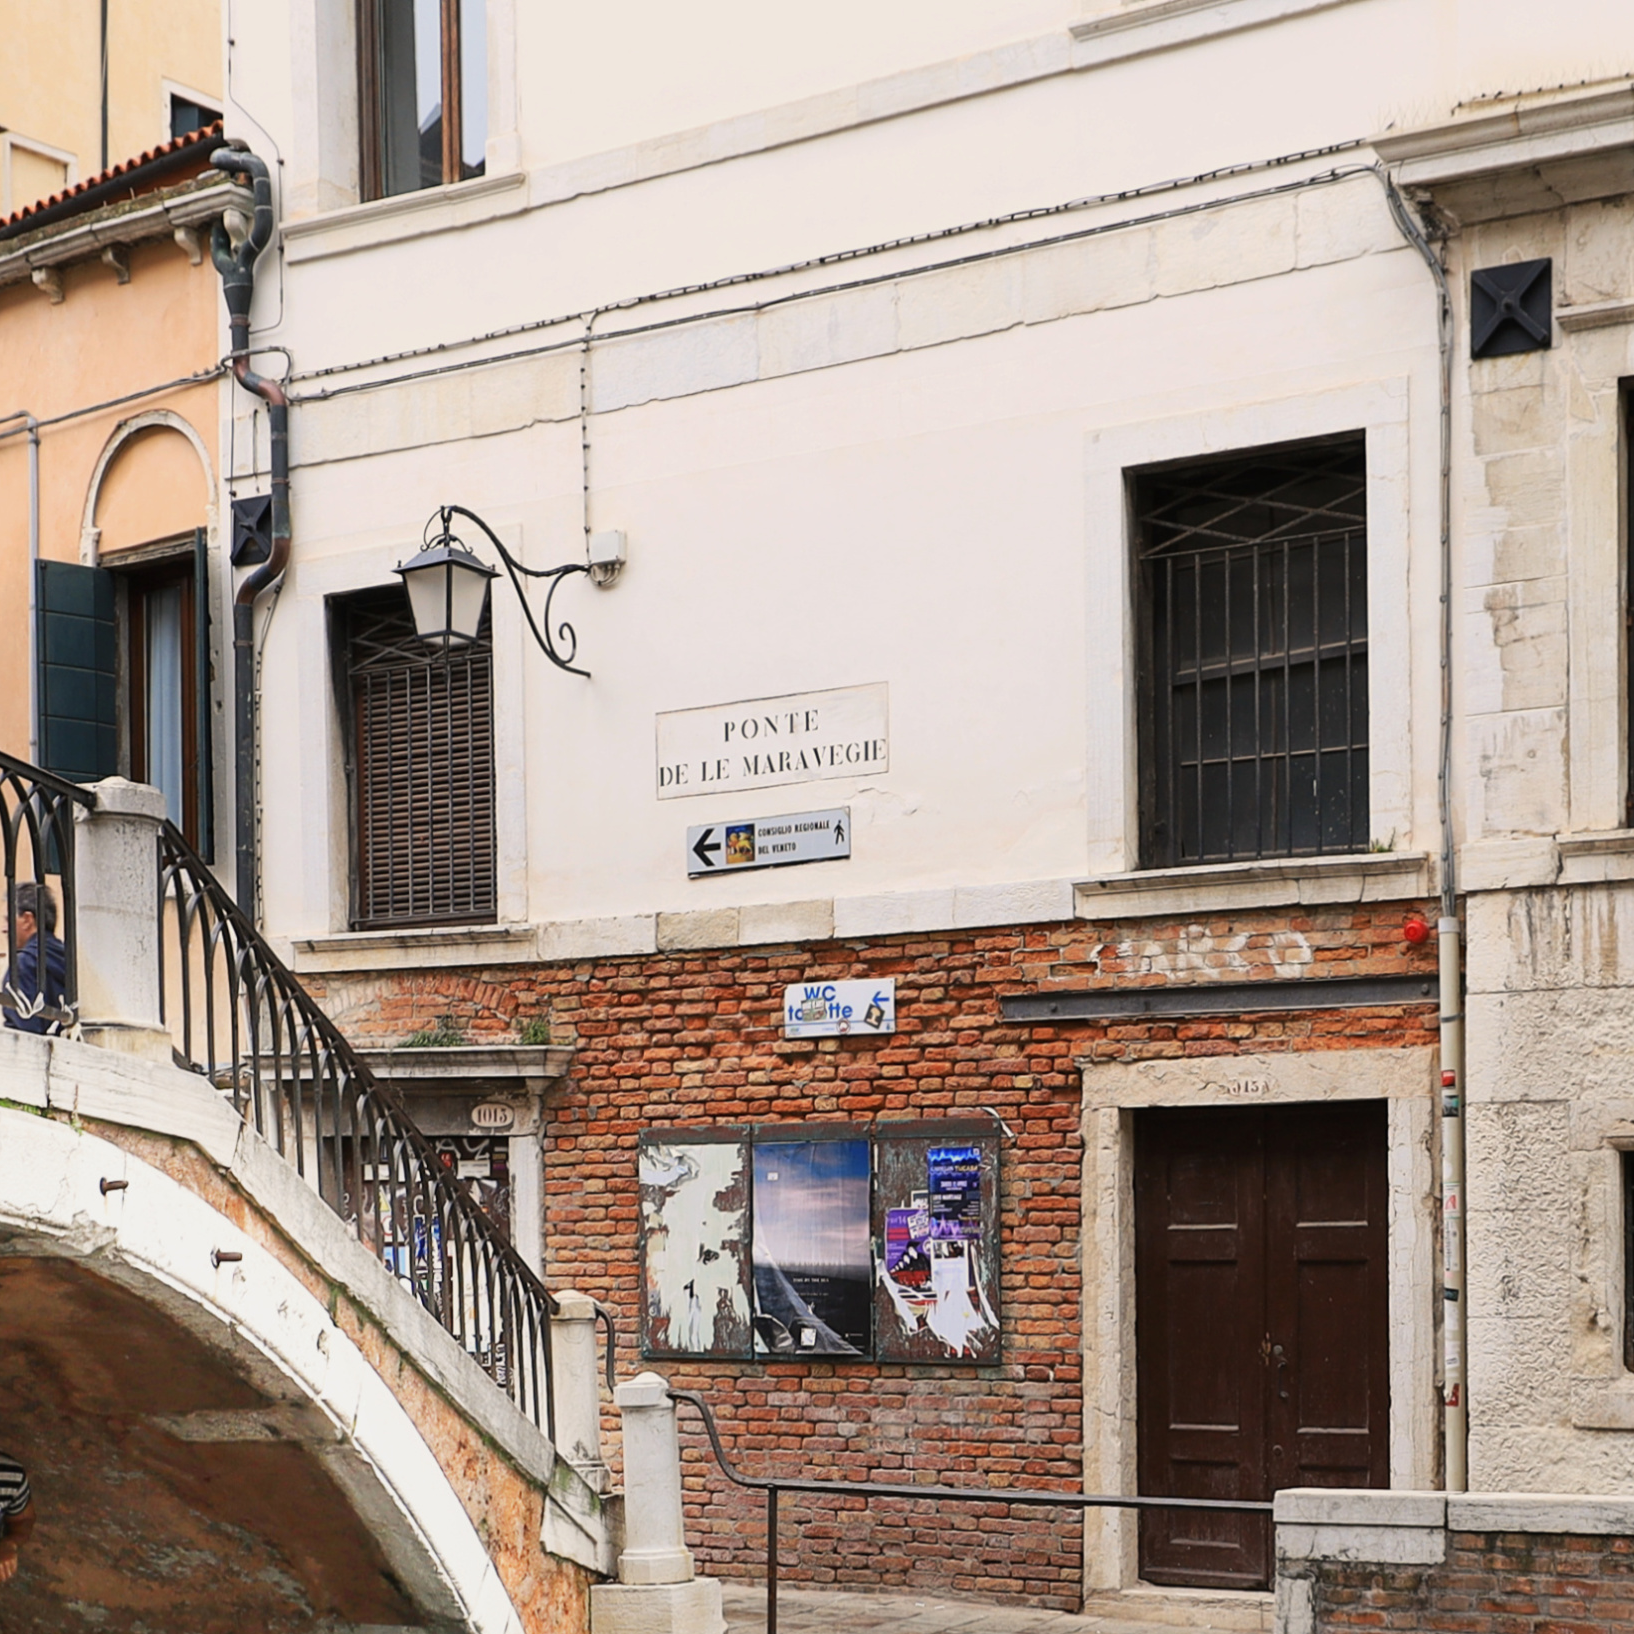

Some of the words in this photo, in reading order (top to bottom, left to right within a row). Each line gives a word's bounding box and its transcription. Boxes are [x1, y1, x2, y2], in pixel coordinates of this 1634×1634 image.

[724, 709, 819, 743] PONTE
[659, 763, 689, 787] DE
[701, 758, 730, 782] LE
[743, 738, 886, 777] MARAVEGIE
[757, 825, 792, 837] CONSIGLIO
[794, 819, 830, 833] REGIONALE
[758, 845, 769, 855] DEL
[772, 842, 797, 853] VENETO
[804, 985, 836, 1002] WC
[787, 1002, 853, 1021] totte
[477, 1107, 508, 1124] 1015
